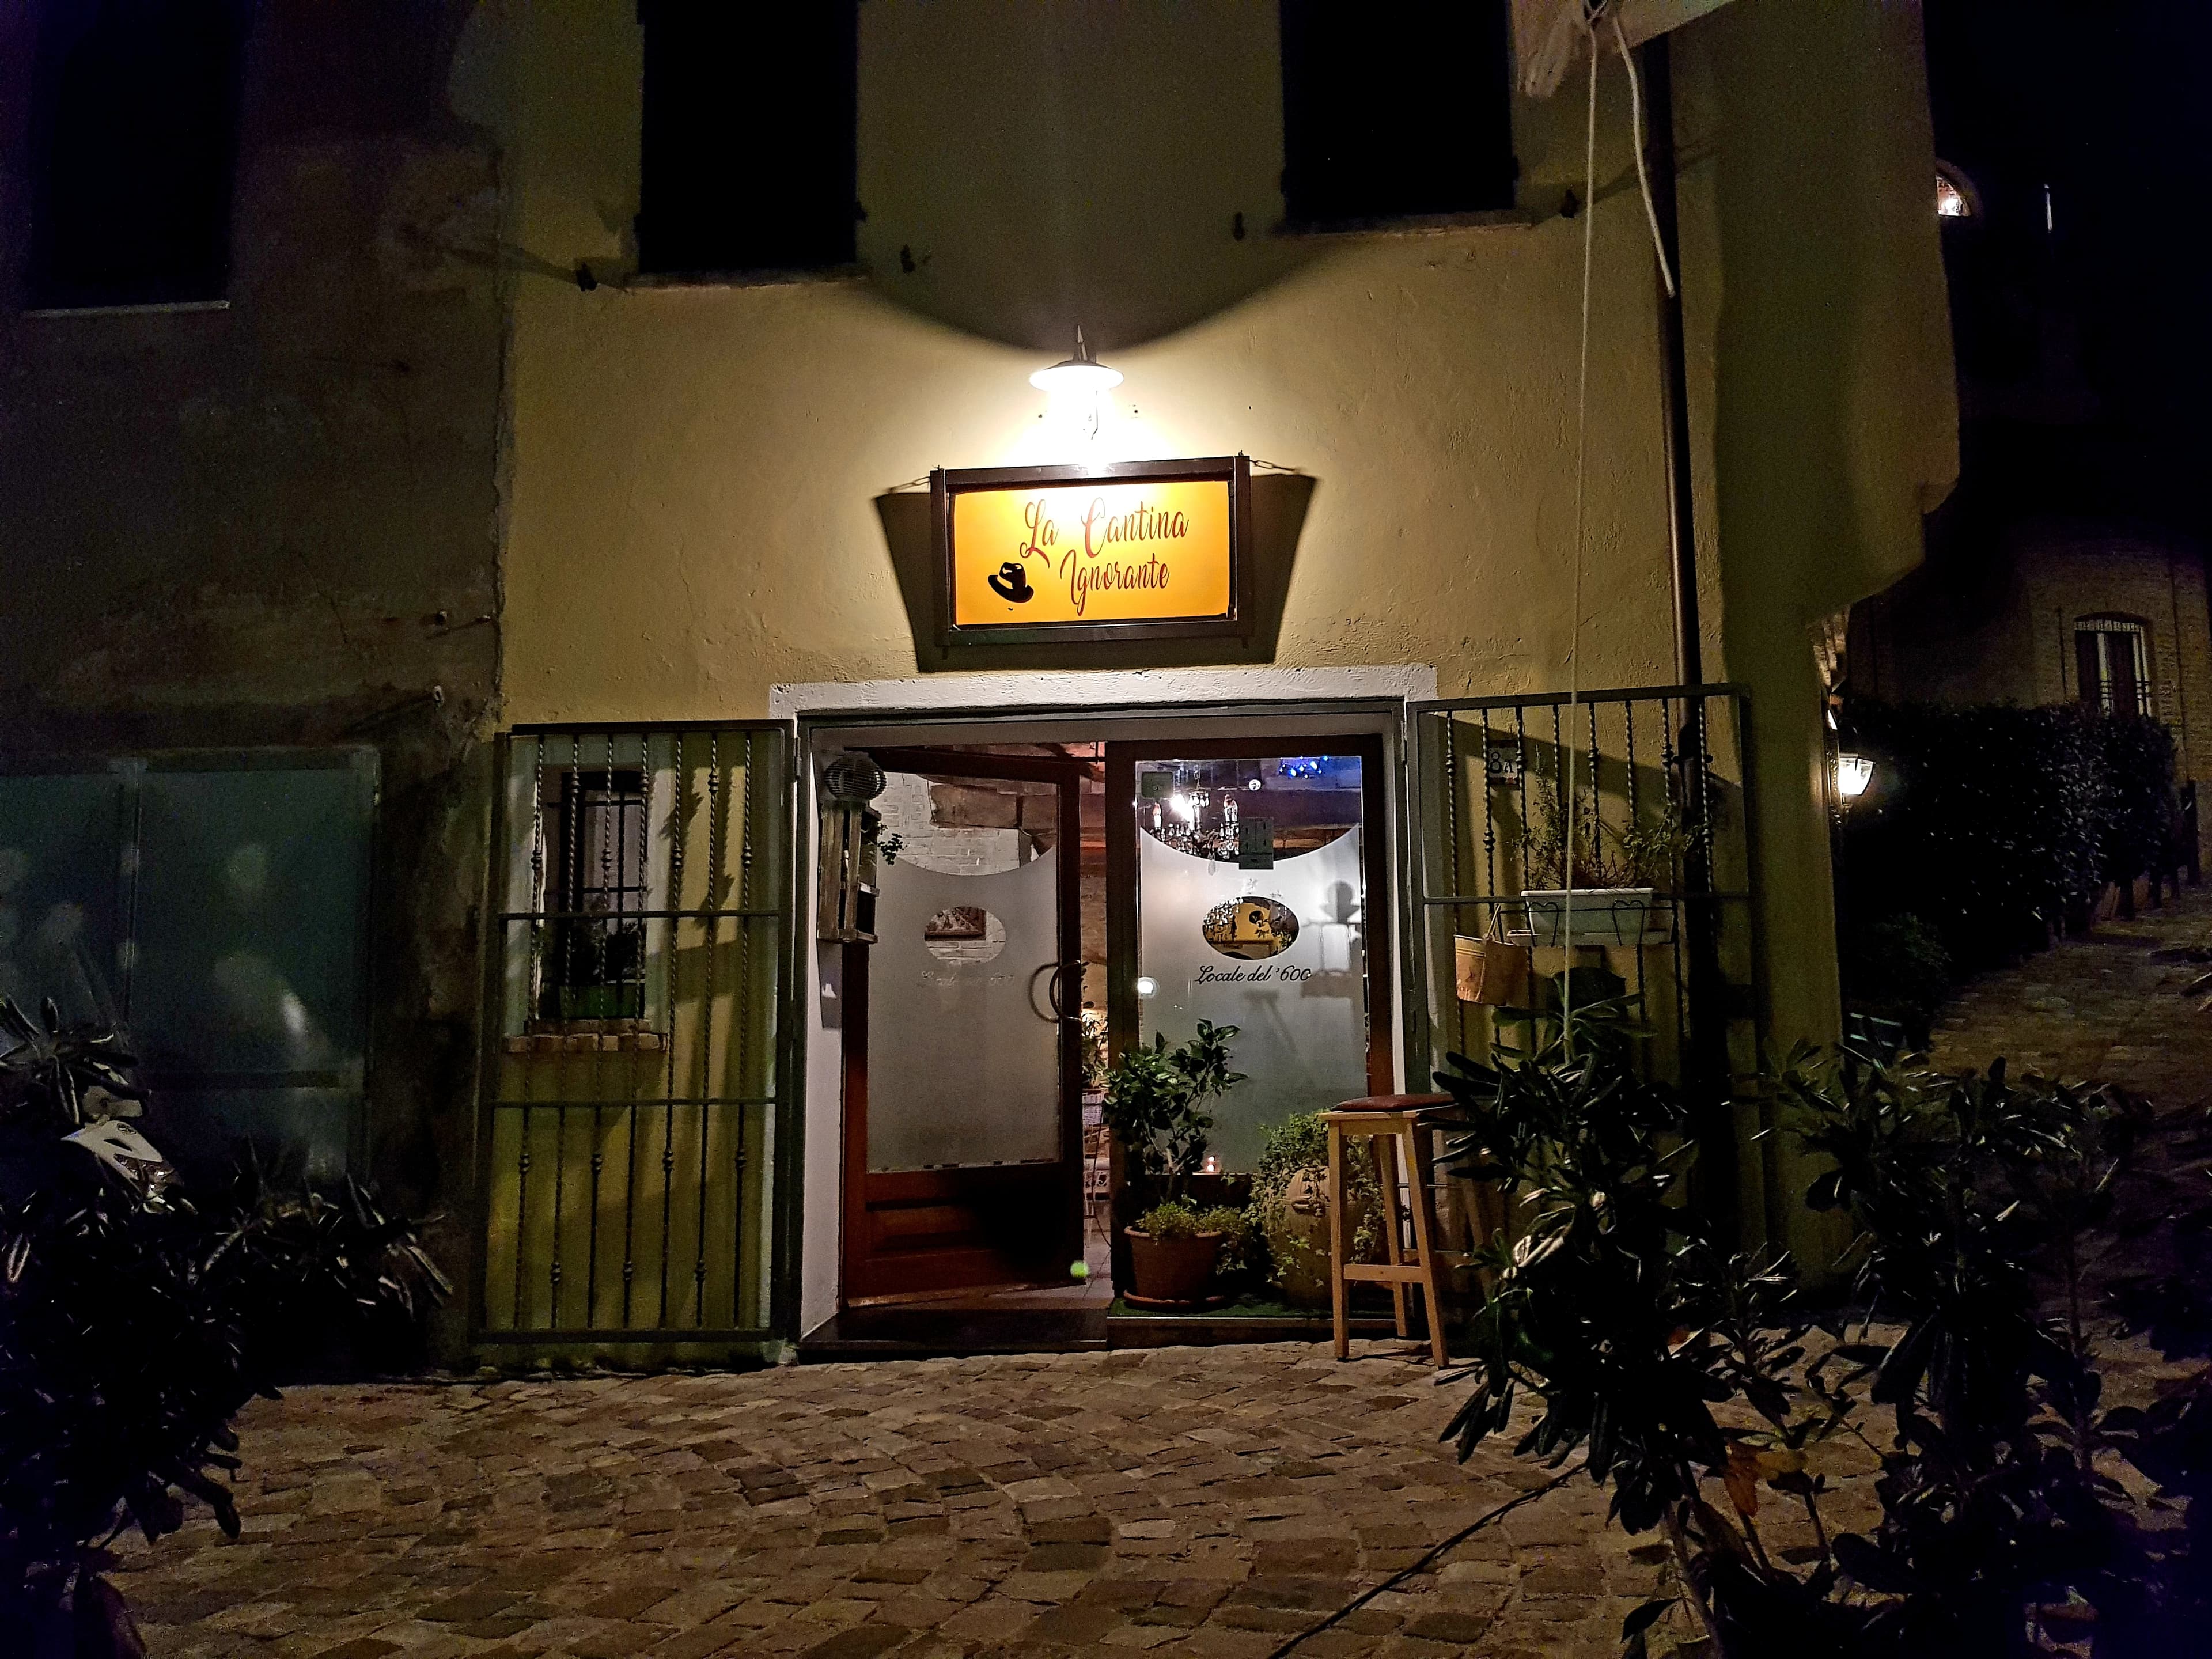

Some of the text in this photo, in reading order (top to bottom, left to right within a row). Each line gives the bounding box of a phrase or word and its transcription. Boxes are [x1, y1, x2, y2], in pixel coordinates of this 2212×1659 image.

[1020, 498, 1189, 568] La Cantina
[1060, 548, 1170, 616] Ignorante
[1195, 965, 1245, 984] Locale
[1247, 965, 1272, 981] del
